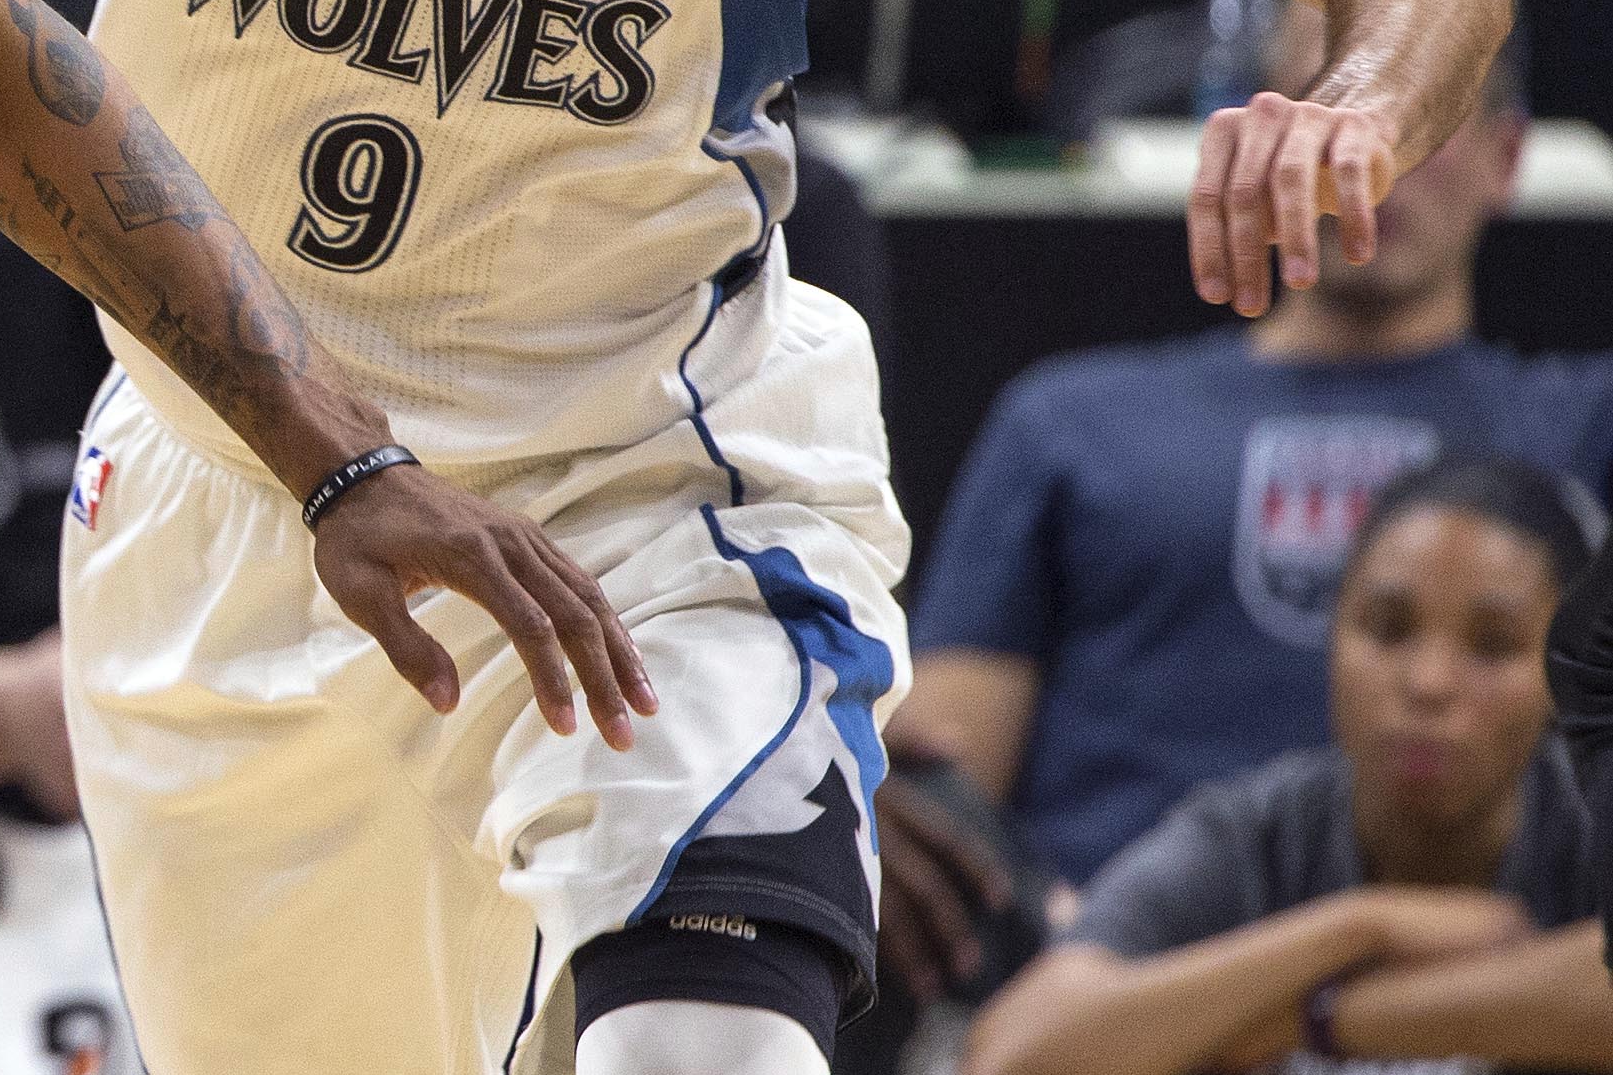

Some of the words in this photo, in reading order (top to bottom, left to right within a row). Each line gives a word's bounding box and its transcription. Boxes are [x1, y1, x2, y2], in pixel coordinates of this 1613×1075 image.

[287, 112, 424, 274] 9
[303, 484, 335, 525] NAME
[335, 474, 344, 487] I
[345, 453, 388, 479] PLAY
[669, 912, 758, 942] adidas
